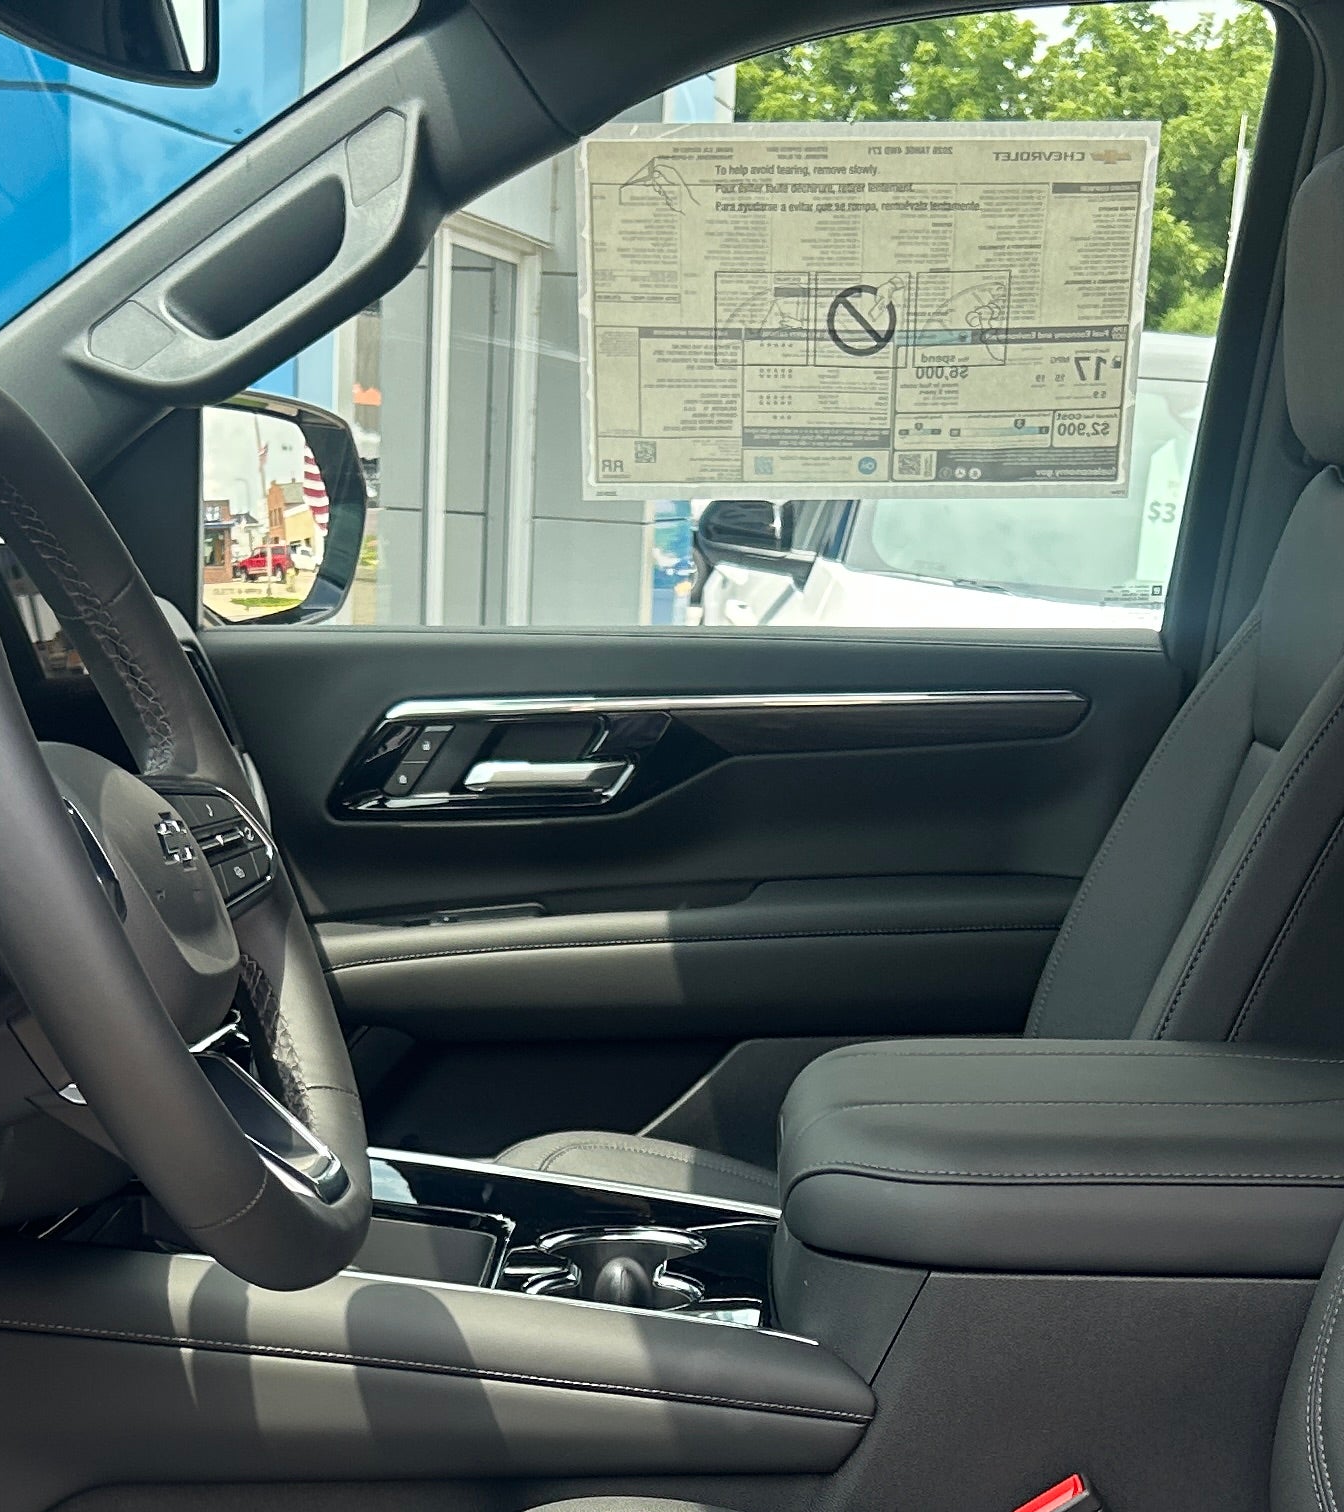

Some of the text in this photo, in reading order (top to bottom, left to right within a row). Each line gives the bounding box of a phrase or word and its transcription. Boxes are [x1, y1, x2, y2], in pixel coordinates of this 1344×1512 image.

[715, 165, 727, 175] To
[729, 165, 748, 176] help
[750, 165, 774, 175] avoid
[777, 165, 810, 177] tearing,
[813, 166, 847, 175] remove
